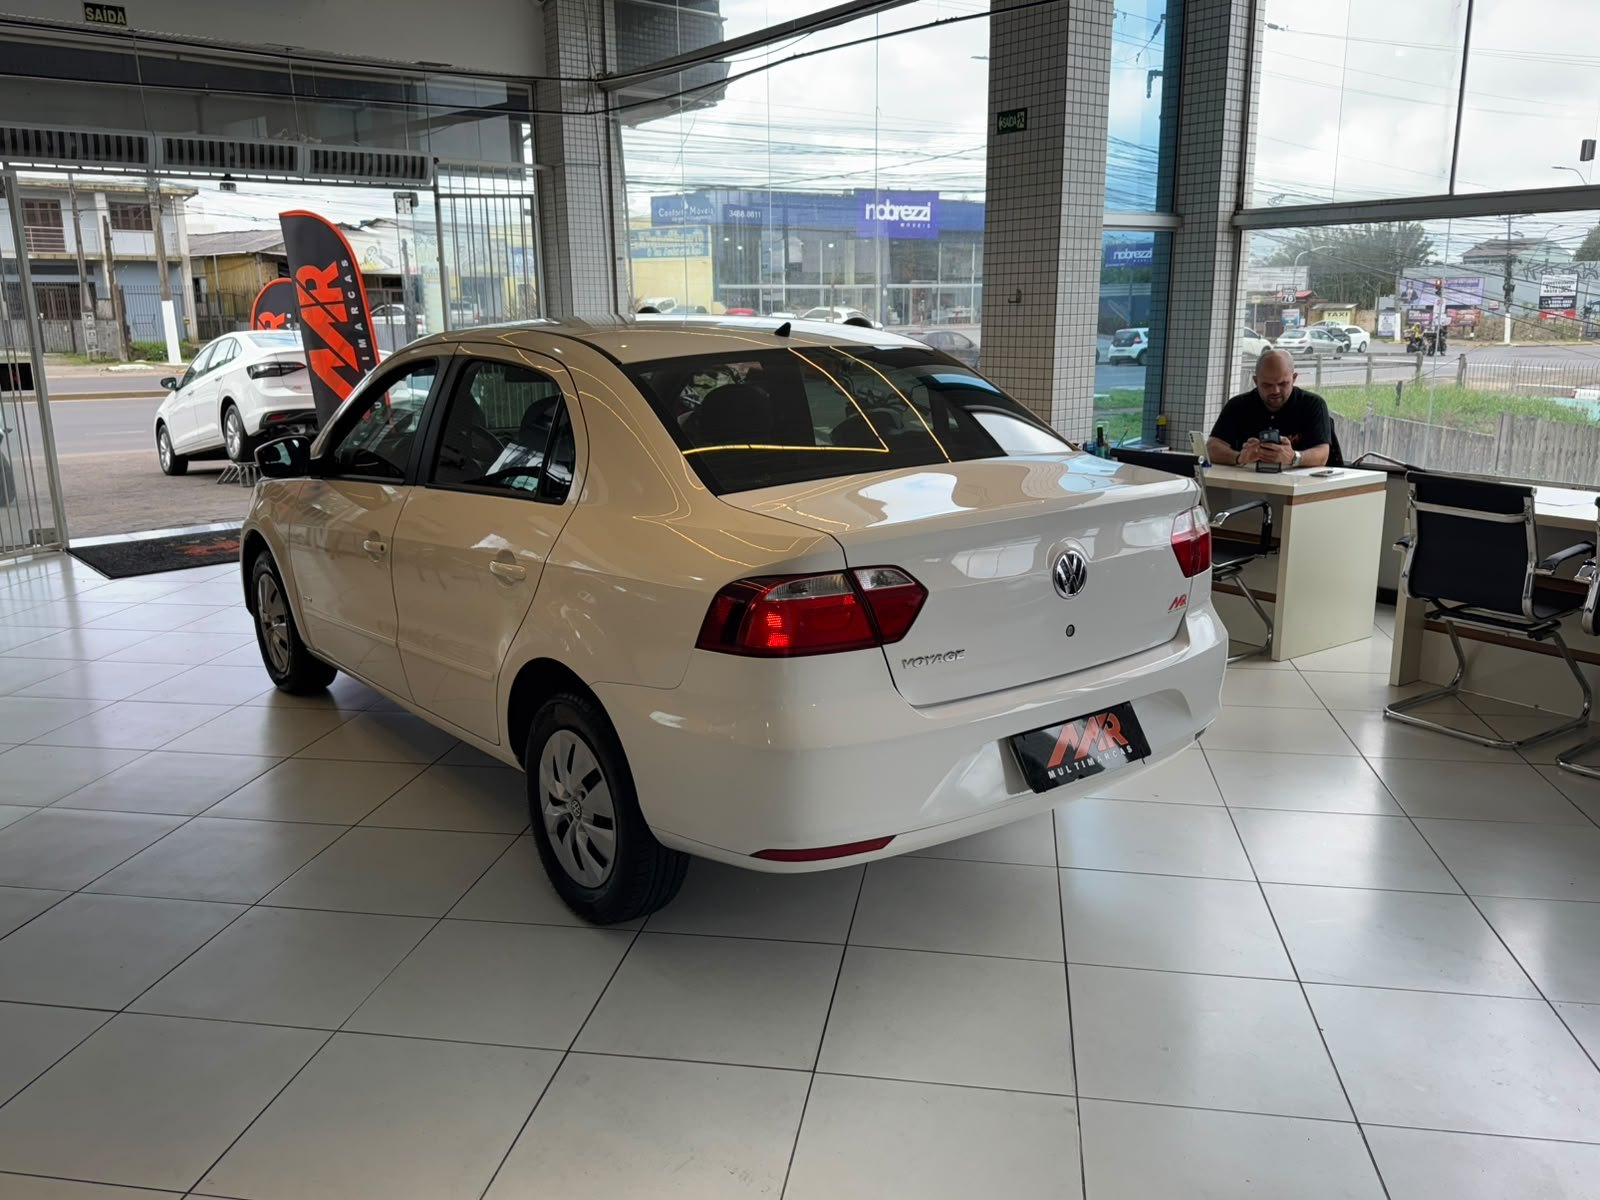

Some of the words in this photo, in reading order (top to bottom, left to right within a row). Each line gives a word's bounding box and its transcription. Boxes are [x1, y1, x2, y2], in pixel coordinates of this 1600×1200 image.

[85, 5, 126, 24] SAÍDA
[865, 199, 931, 221] nobrezzi
[902, 649, 965, 669] VOYAGE
[1047, 744, 1133, 780] MULTIMARCAS
